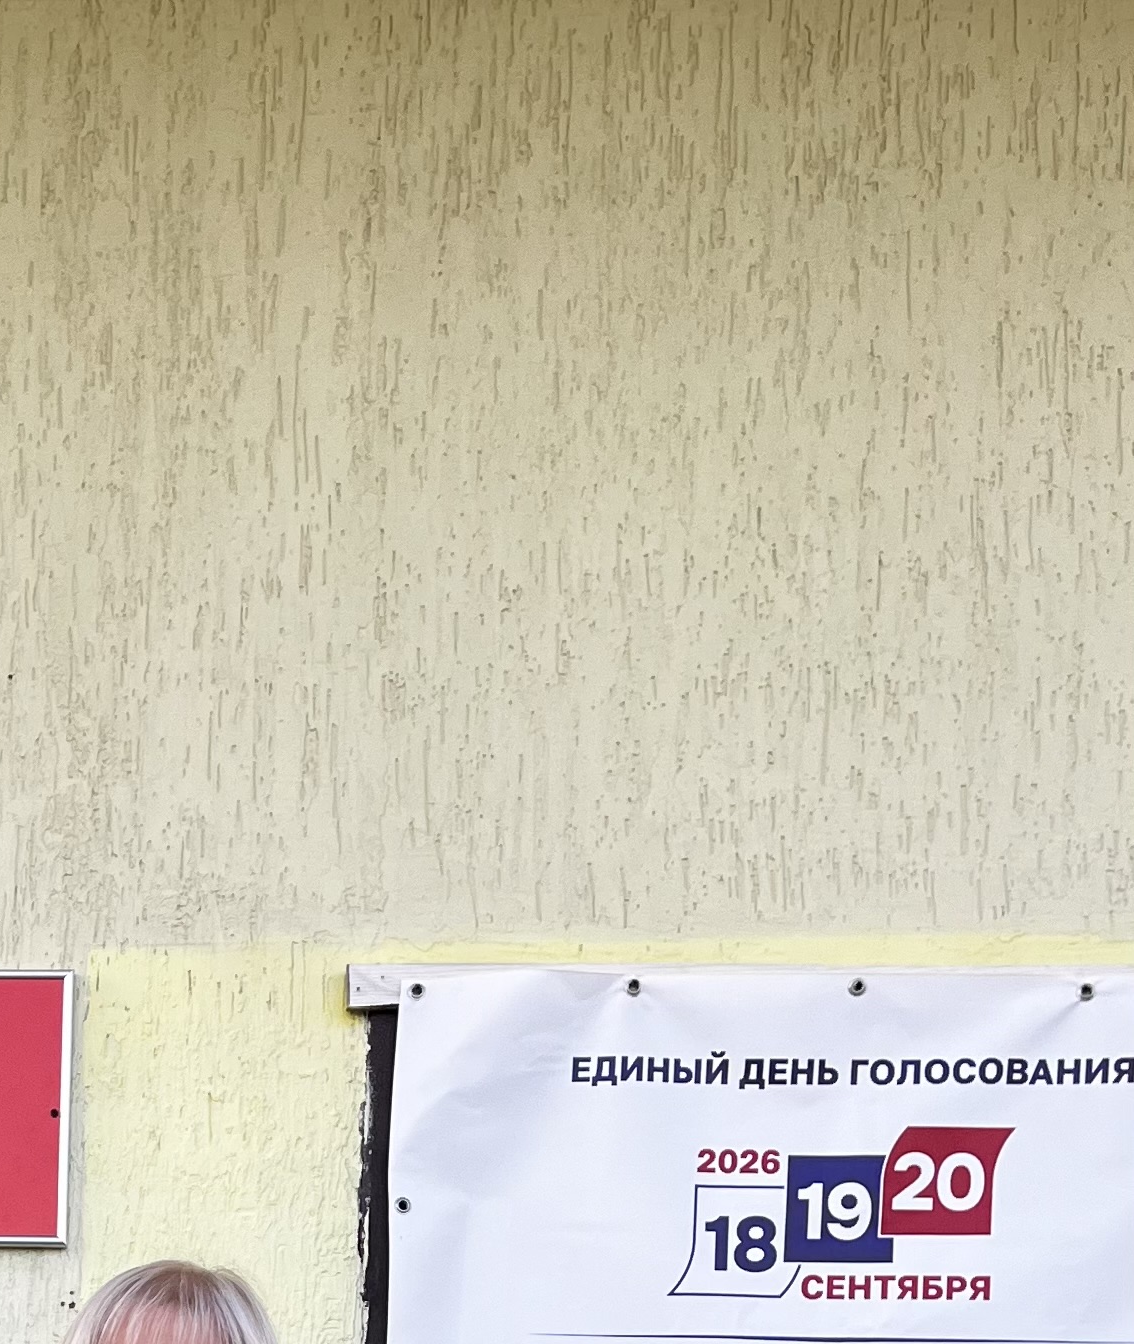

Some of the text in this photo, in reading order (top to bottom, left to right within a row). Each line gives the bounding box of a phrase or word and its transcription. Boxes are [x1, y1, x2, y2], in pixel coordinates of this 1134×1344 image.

[572, 1051, 1134, 1090] ЕДИНЫЙ ДЕНЬ ГОЛОСОВАНИЯ
[697, 1149, 780, 1174] 2026
[705, 1152, 985, 1272] 18 19 20
[801, 1275, 991, 1301] СЕНТЯБРЯ
